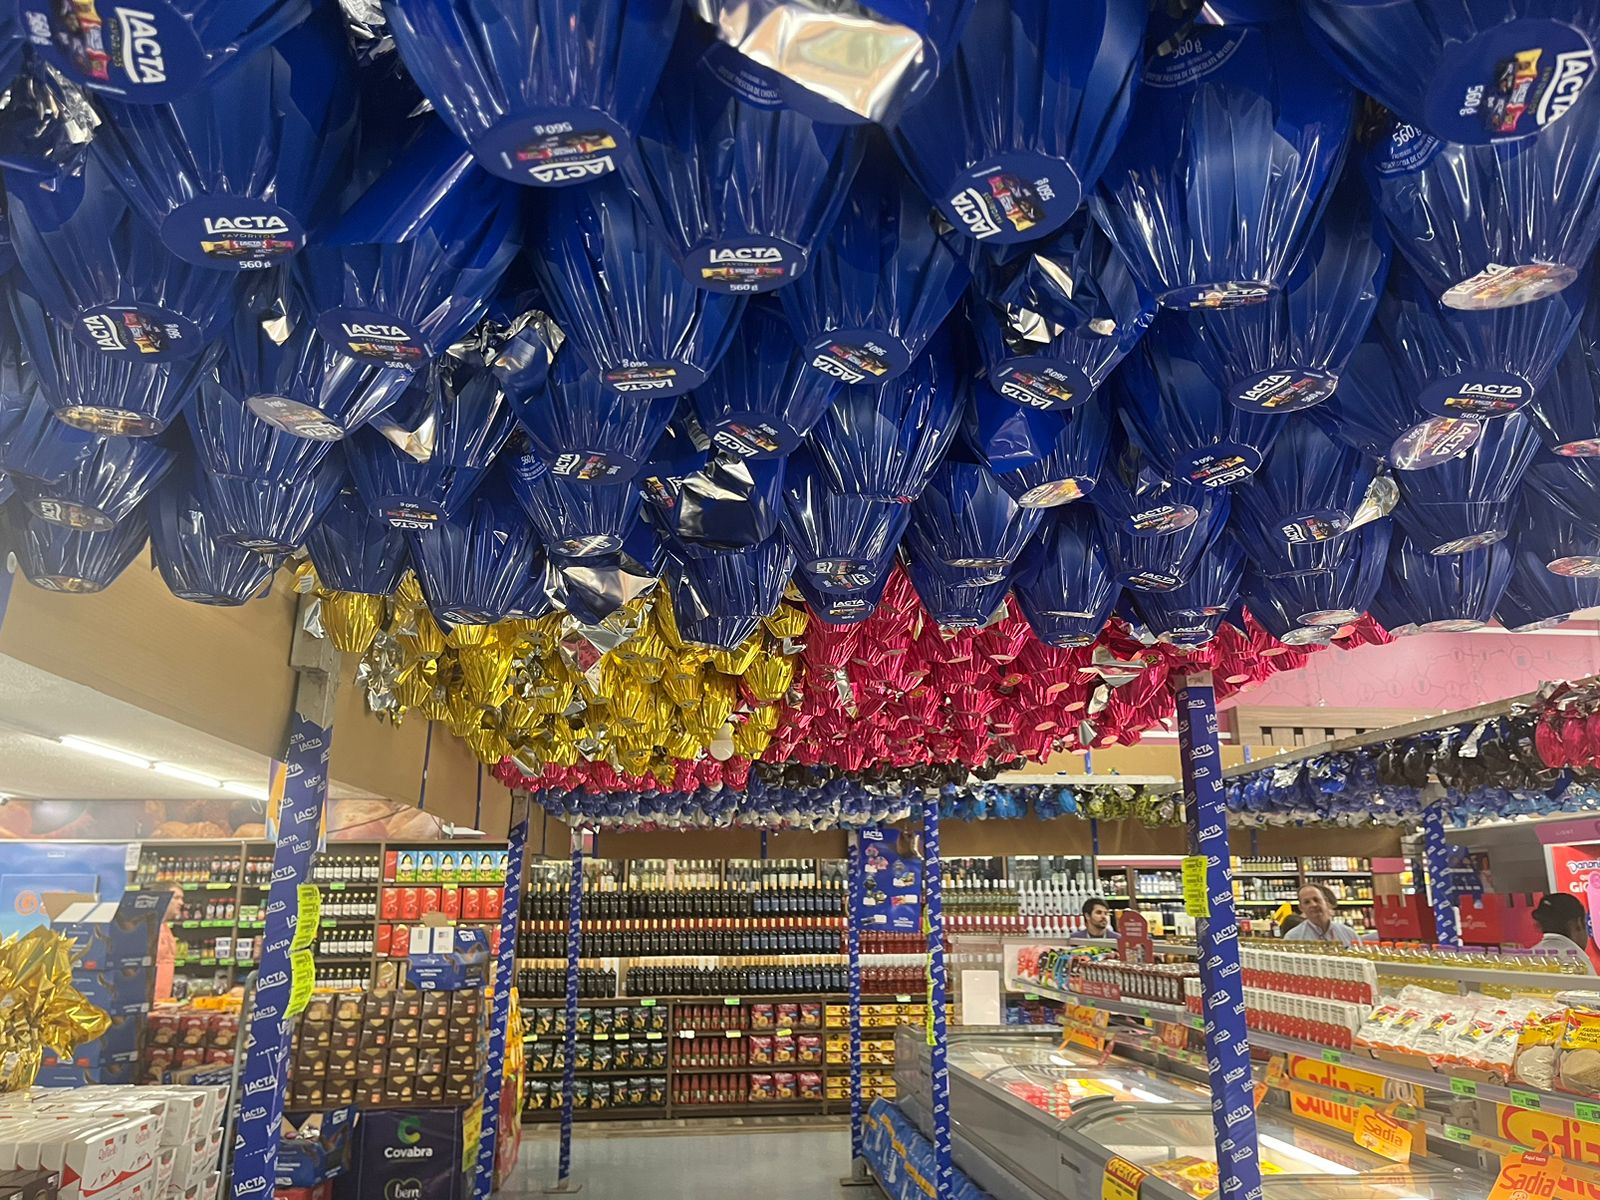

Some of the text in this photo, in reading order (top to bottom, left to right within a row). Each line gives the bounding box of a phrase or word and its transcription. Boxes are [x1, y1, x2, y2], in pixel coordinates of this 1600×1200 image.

[115, 6, 167, 83] LACTA
[1536, 50, 1593, 125] LACTA
[529, 155, 616, 183] LACTA
[950, 188, 1002, 240] LACTA
[204, 216, 288, 234] LACTA
[710, 247, 782, 263] LACTA
[83, 314, 127, 351] LACTA
[341, 323, 411, 341] LACTA
[812, 355, 865, 384] LACTA
[613, 379, 674, 392] LACTA
[1001, 381, 1054, 410] LACTA
[1239, 374, 1292, 401] LACTA
[1459, 383, 1523, 398] LACTA
[714, 430, 759, 458] LACTA
[552, 453, 580, 476] LACTA
[1202, 465, 1253, 488] LACTA
[390, 518, 433, 530] LACTA
[1131, 505, 1174, 523] LACTA
[1139, 571, 1176, 585] LACTA
[833, 597, 865, 608] LACTA
[1173, 624, 1206, 634] LACTA
[300, 737, 322, 752] LACTA
[1212, 891, 1233, 906] LACTA
[1212, 924, 1238, 944] LACTA
[266, 939, 290, 953] LACTA
[1219, 962, 1240, 978] LACTA
[257, 971, 288, 992] LACTA
[244, 1074, 278, 1096] LACTA
[242, 1107, 267, 1122] LACTA
[1224, 1104, 1252, 1128] LACTA
[1364, 1114, 1403, 1147] Sadia
[384, 1146, 433, 1158] Covabra
[1231, 1146, 1253, 1163] LACTA
[234, 1175, 266, 1198] LACTA
[1500, 1163, 1556, 1197] Sadia
